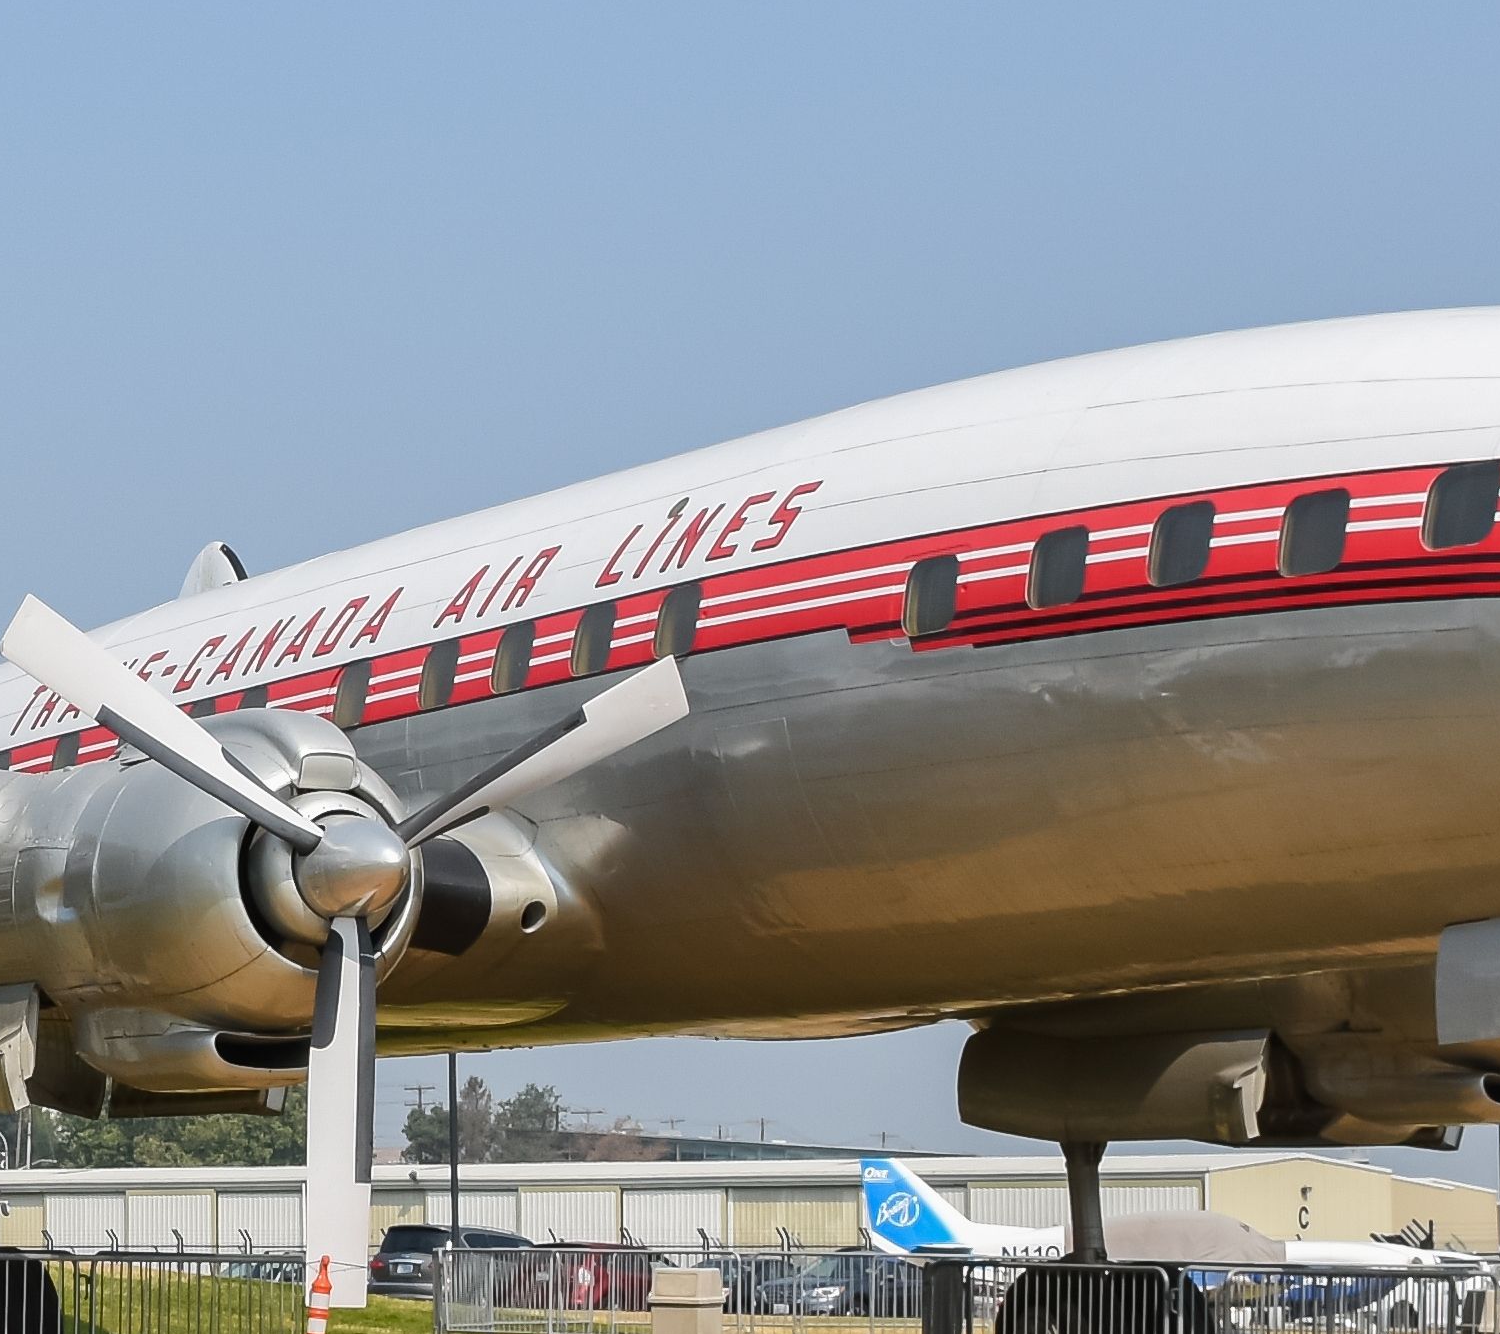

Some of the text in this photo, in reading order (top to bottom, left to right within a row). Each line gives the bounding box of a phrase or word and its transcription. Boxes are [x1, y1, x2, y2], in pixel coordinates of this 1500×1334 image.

[10, 479, 825, 736] TRAS-CANADA AIR LINES
[1298, 1205, 1310, 1230] C
